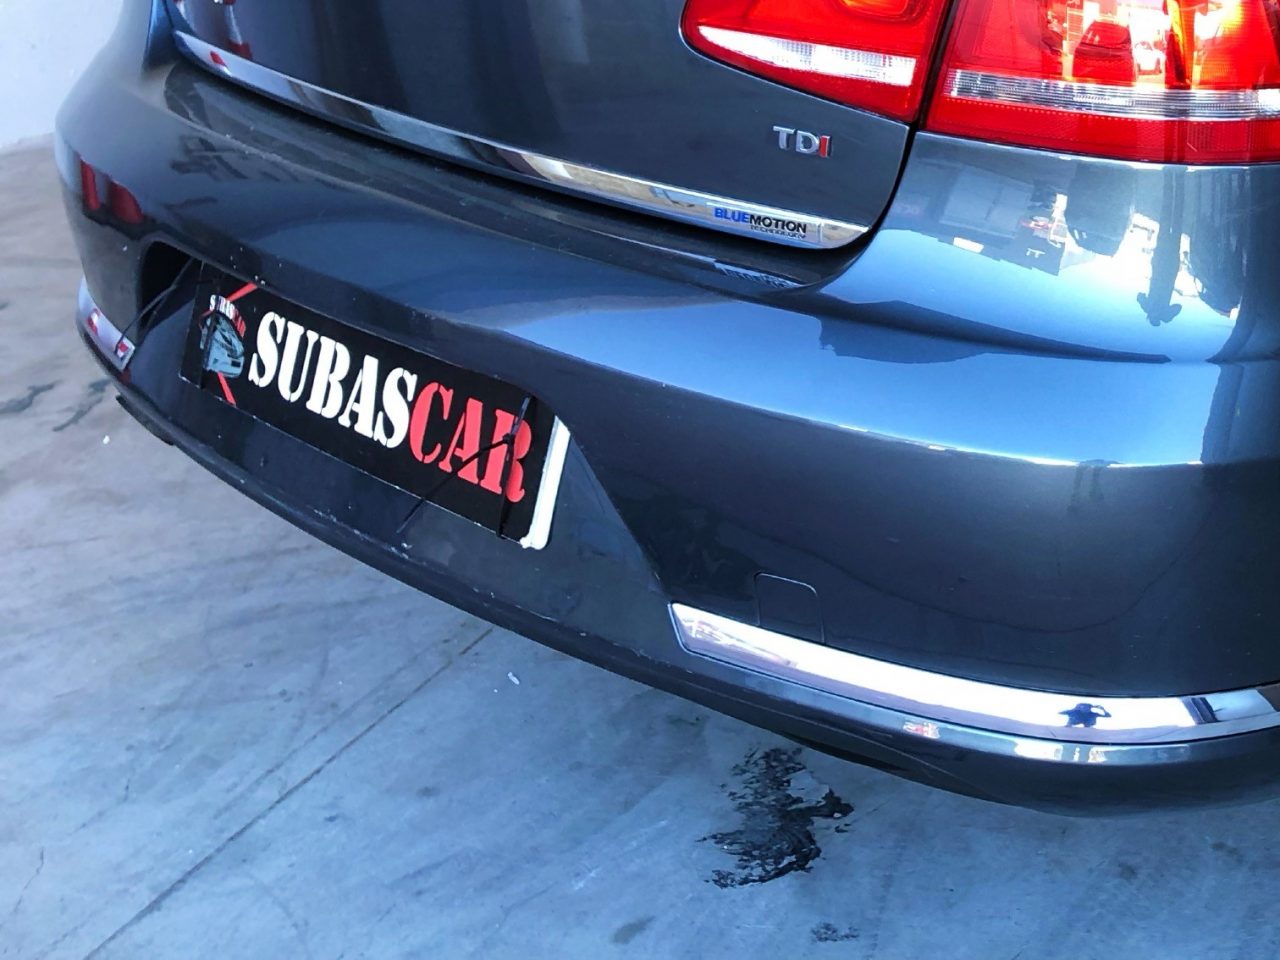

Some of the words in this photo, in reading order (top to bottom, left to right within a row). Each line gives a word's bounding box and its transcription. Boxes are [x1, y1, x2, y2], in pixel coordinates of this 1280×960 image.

[772, 125, 831, 158] TDI
[714, 206, 807, 234] BLUEMOTION
[247, 311, 533, 503] SUBASCAR
